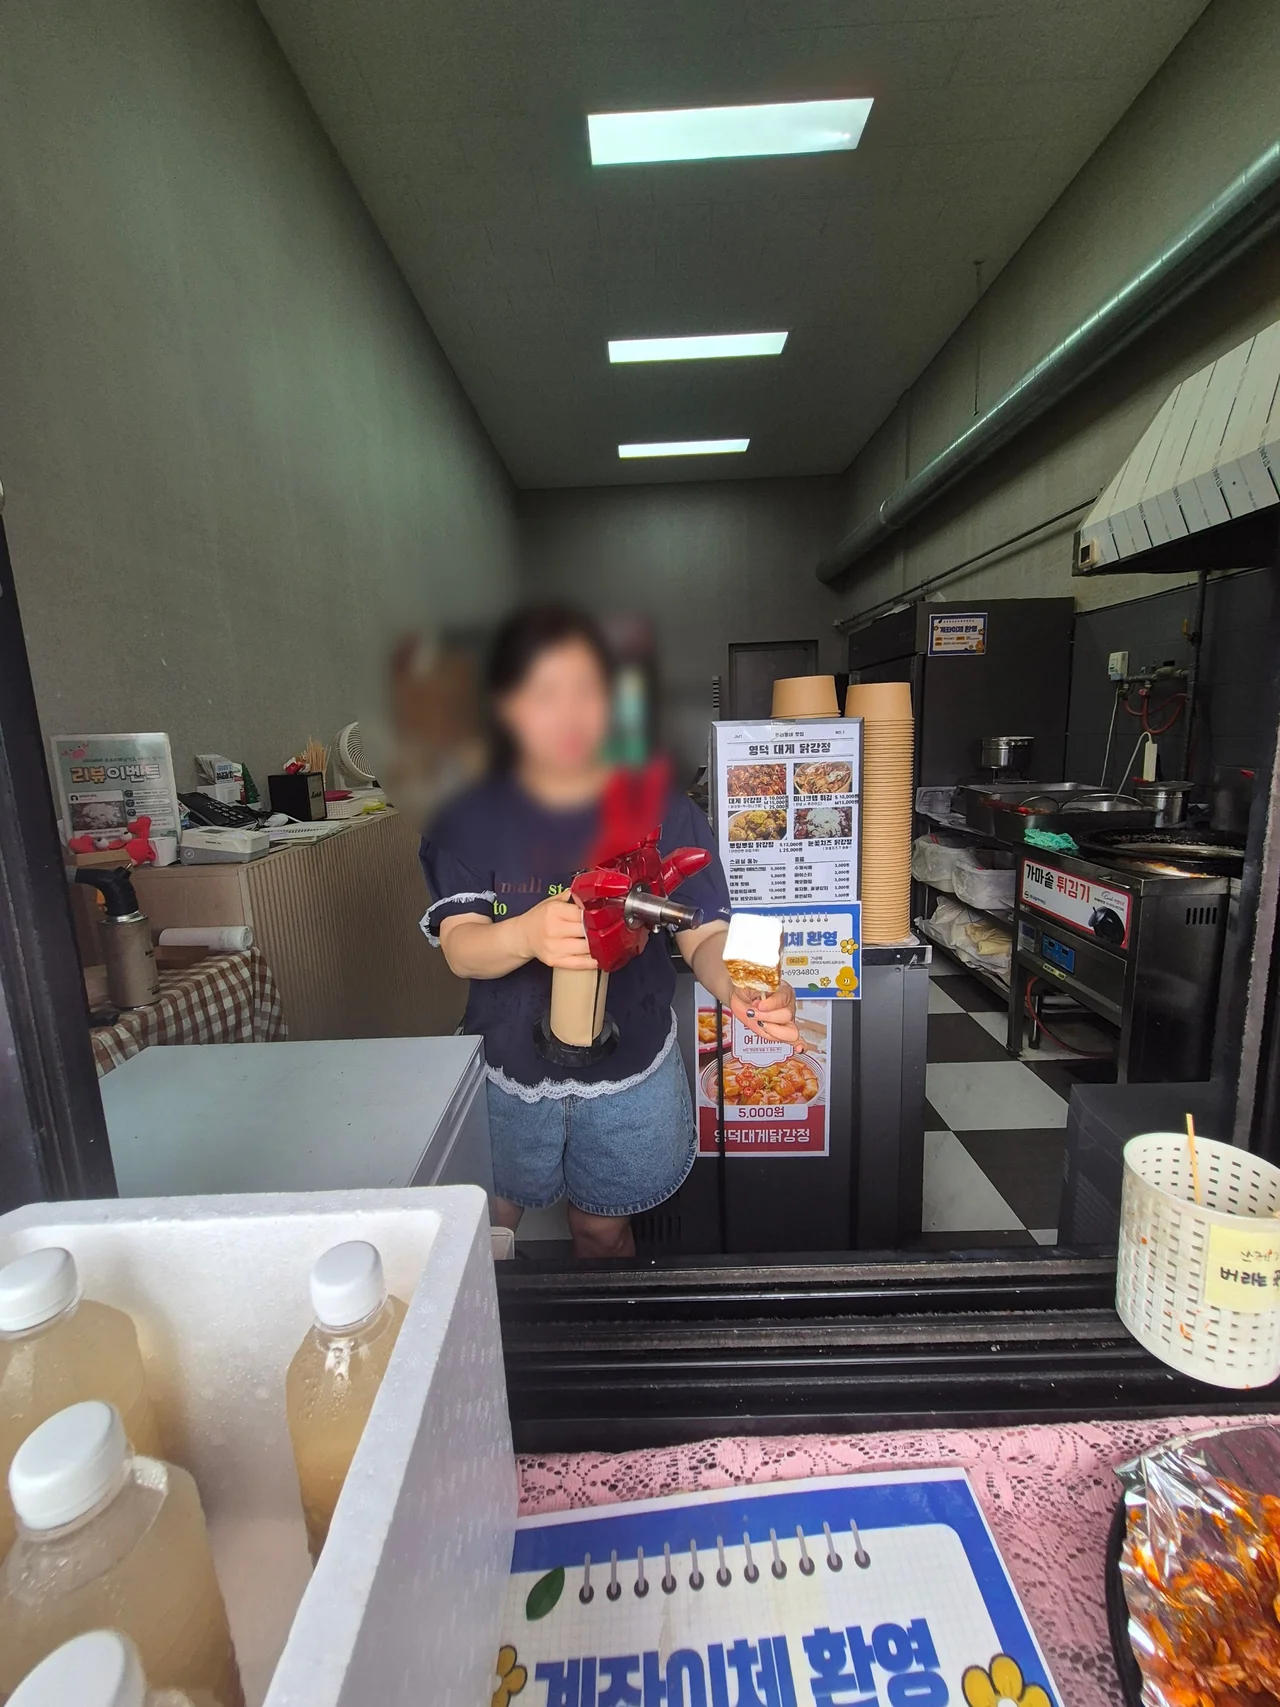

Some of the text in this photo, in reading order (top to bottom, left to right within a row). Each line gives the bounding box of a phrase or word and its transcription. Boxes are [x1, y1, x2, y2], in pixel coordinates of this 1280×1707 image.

[748, 742, 831, 756] 영덕 대게 닭강정
[69, 763, 161, 784] 리뷰이벤트
[834, 838, 853, 846] 닭강정
[1025, 863, 1055, 890] 가마솥
[1056, 875, 1091, 904] 튀김기
[493, 900, 508, 915] to
[806, 930, 838, 947] 환영
[738, 1106, 785, 1118] 5,000원
